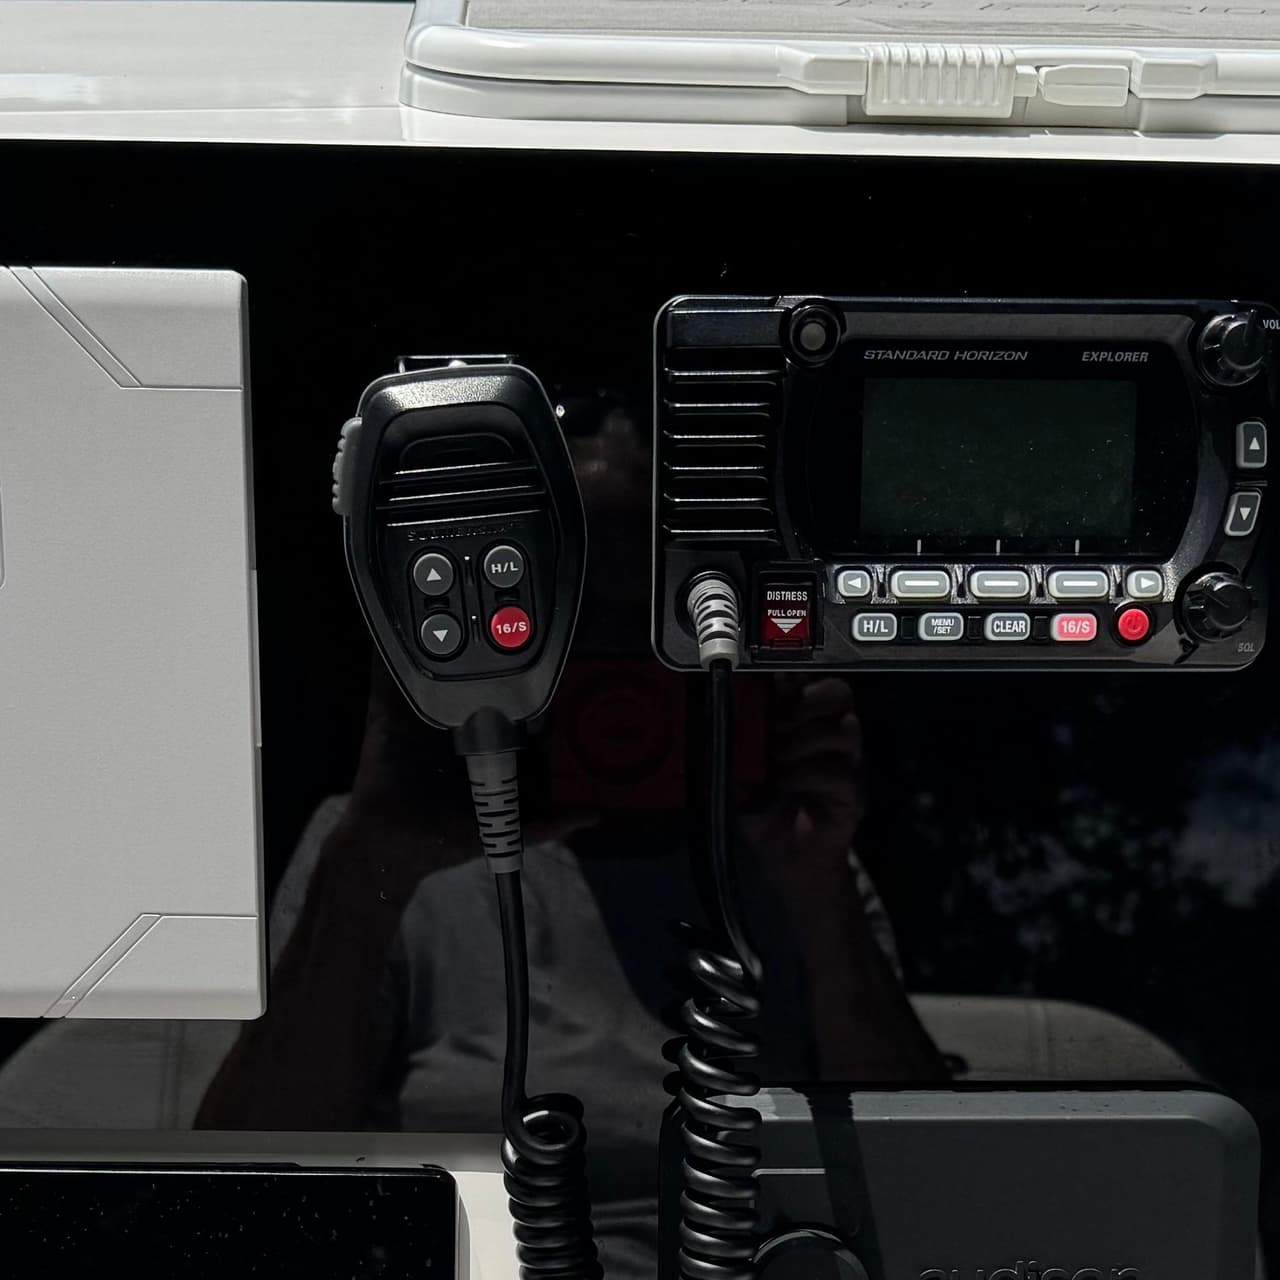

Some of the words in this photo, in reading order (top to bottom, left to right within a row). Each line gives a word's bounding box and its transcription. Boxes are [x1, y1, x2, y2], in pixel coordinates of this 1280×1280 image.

[863, 350, 950, 362] STANDARD
[953, 350, 1029, 362] HORIZON
[1081, 351, 1150, 363] EXPLORER
[490, 561, 520, 574] H/L
[767, 590, 808, 602] DISTRESS
[767, 608, 786, 617] PULL
[786, 608, 807, 617] OPEN
[495, 621, 527, 635] 16/S
[863, 619, 889, 634] H/L
[931, 618, 955, 626] MENU
[993, 620, 1026, 633] CLEAR
[1061, 619, 1091, 634] 16/S
